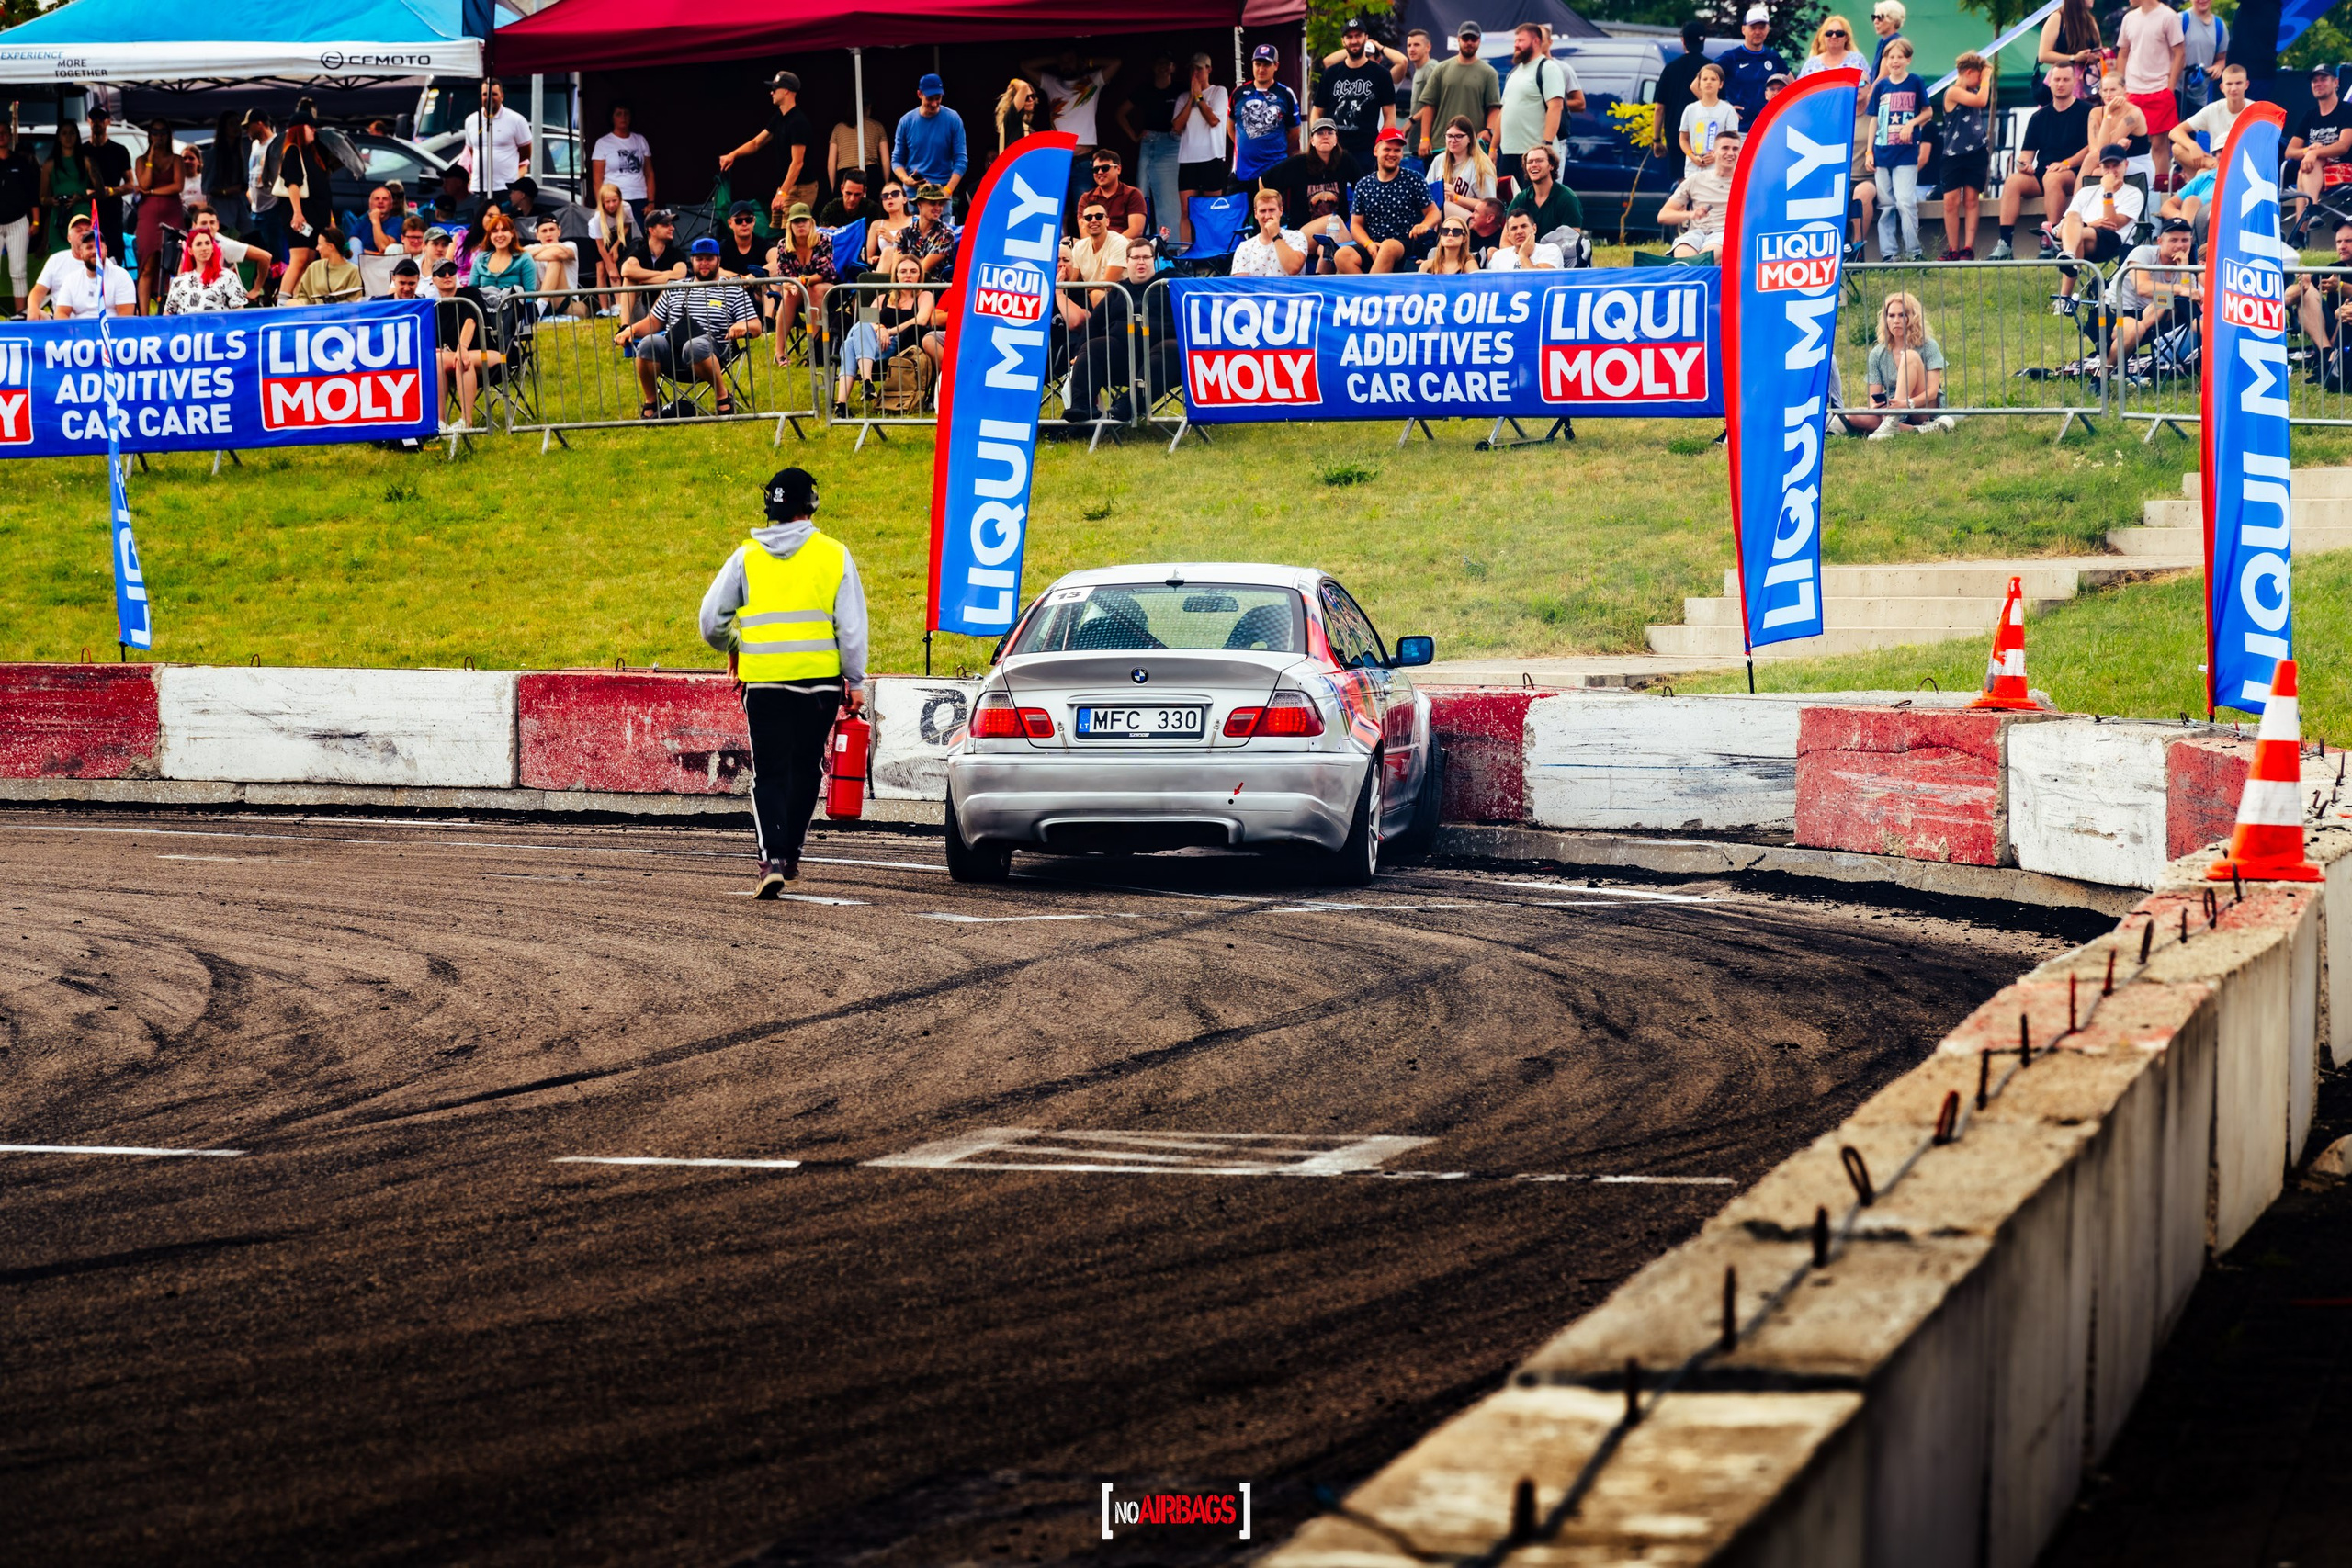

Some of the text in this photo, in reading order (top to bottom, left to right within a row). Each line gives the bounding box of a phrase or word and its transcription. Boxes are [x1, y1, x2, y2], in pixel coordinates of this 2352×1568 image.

[55, 69, 108, 78] TOGETHER
[57, 59, 87, 68] MORE
[349, 55, 431, 65] CFMOTO
[1761, 231, 1835, 261] LIQUI
[981, 266, 1040, 294] LIQUI
[1761, 258, 1835, 288] MOLY
[2225, 262, 2281, 299] LIQUI
[978, 290, 1041, 318] MOLY
[1332, 290, 1532, 327] MOTOR OILS
[1548, 288, 1697, 343] LIQUI
[2224, 299, 2282, 328] MOLY
[1191, 298, 1315, 349] LIQUI
[169, 329, 247, 362] OILS
[269, 321, 411, 373] LIQUI
[1340, 331, 1515, 367] ADDITIVES
[1194, 355, 1314, 401] MOLY
[1347, 371, 1513, 404] CAR CARE
[1549, 347, 1702, 398] MOLY
[271, 373, 417, 424] MOLY
[62, 407, 130, 440] CAR
[138, 403, 233, 436] CARE
[963, 419, 1031, 626] LIQUI
[1762, 396, 1821, 629] LIQUI
[1057, 592, 1081, 600] 13
[1093, 710, 1196, 730] MFC 330
